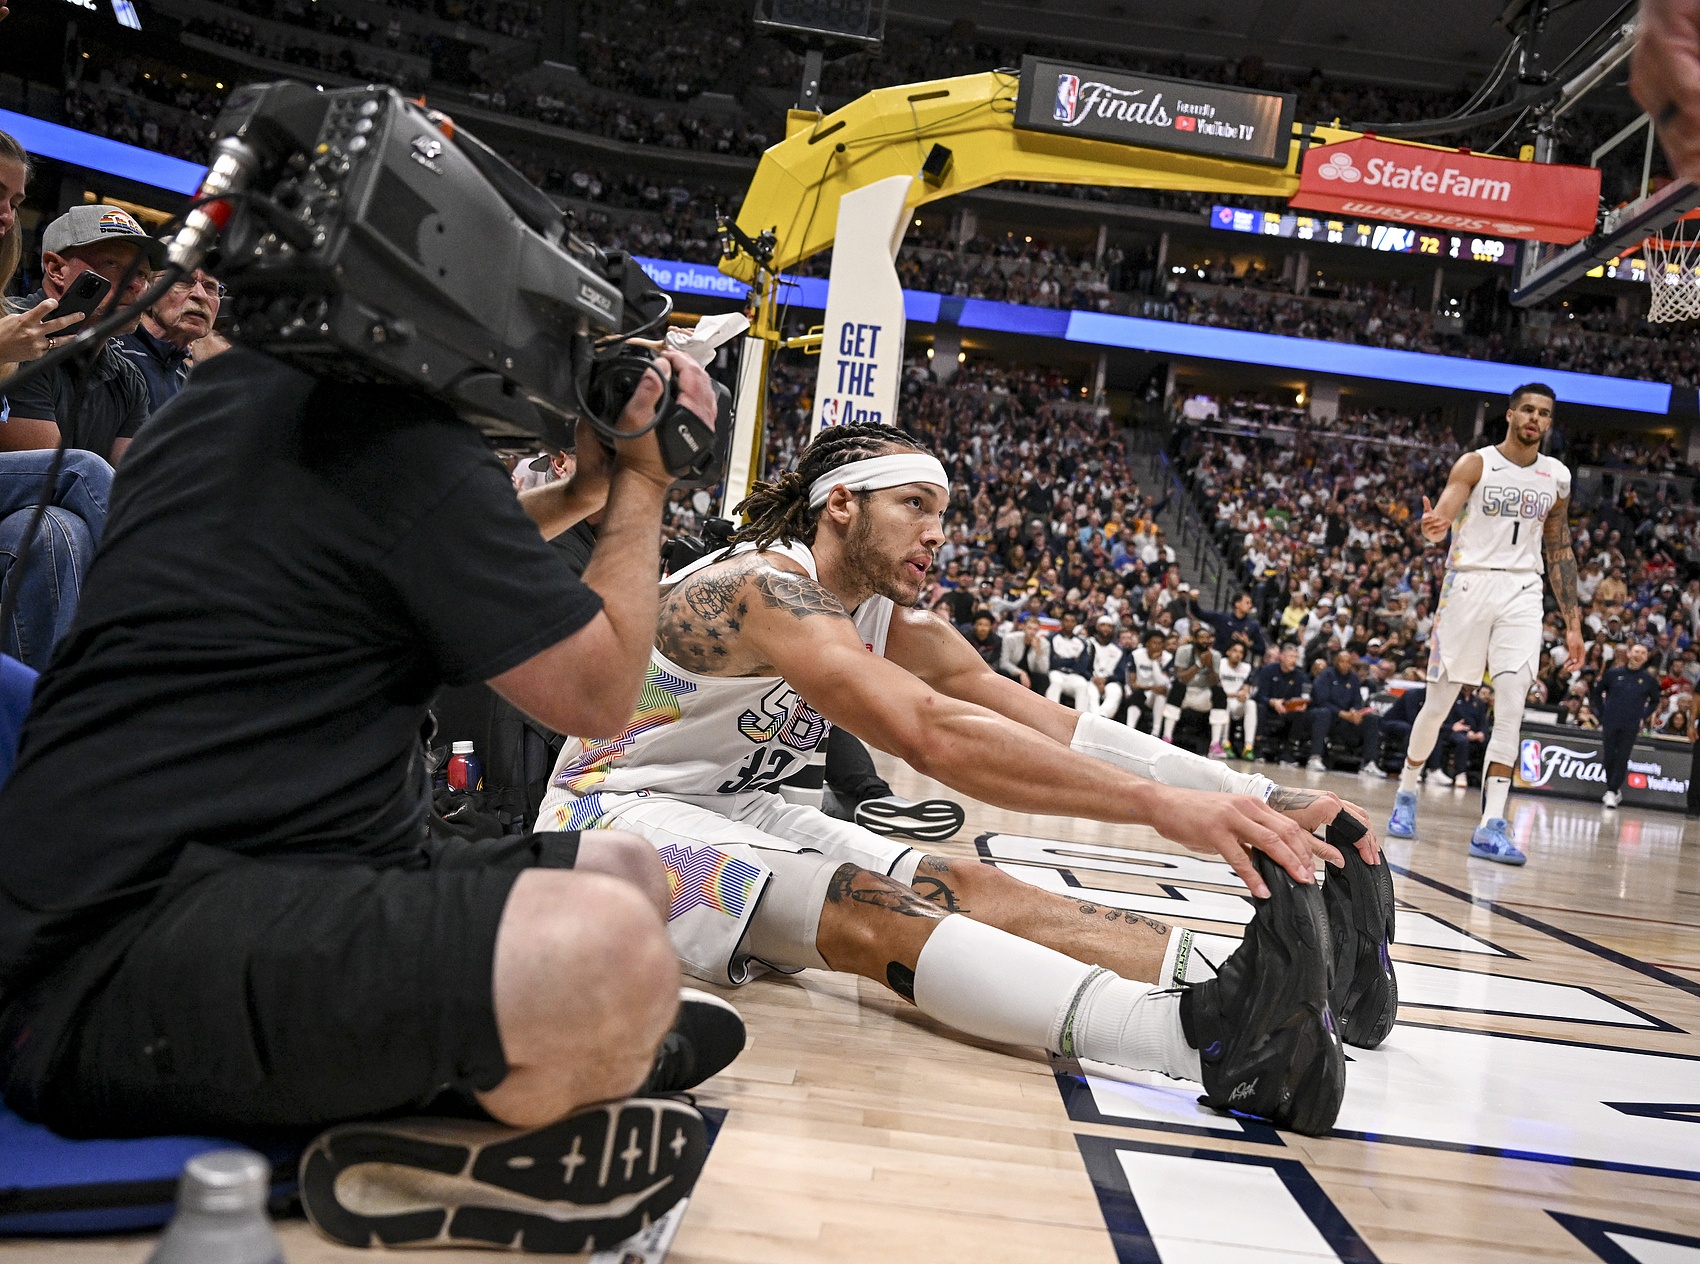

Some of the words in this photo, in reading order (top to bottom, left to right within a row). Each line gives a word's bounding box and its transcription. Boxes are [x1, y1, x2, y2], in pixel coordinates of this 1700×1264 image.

[1062, 82, 1173, 127] Finals
[1197, 118, 1239, 139] YouTube
[1239, 123, 1255, 141] TV
[1420, 236, 1440, 254] 72
[674, 268, 741, 293] planet.
[839, 322, 882, 359] GET
[837, 360, 878, 397] THE
[1482, 486, 1553, 522] 5280
[1511, 521, 1520, 546] 1
[716, 746, 797, 794] 32
[1531, 744, 1608, 787] Fina
